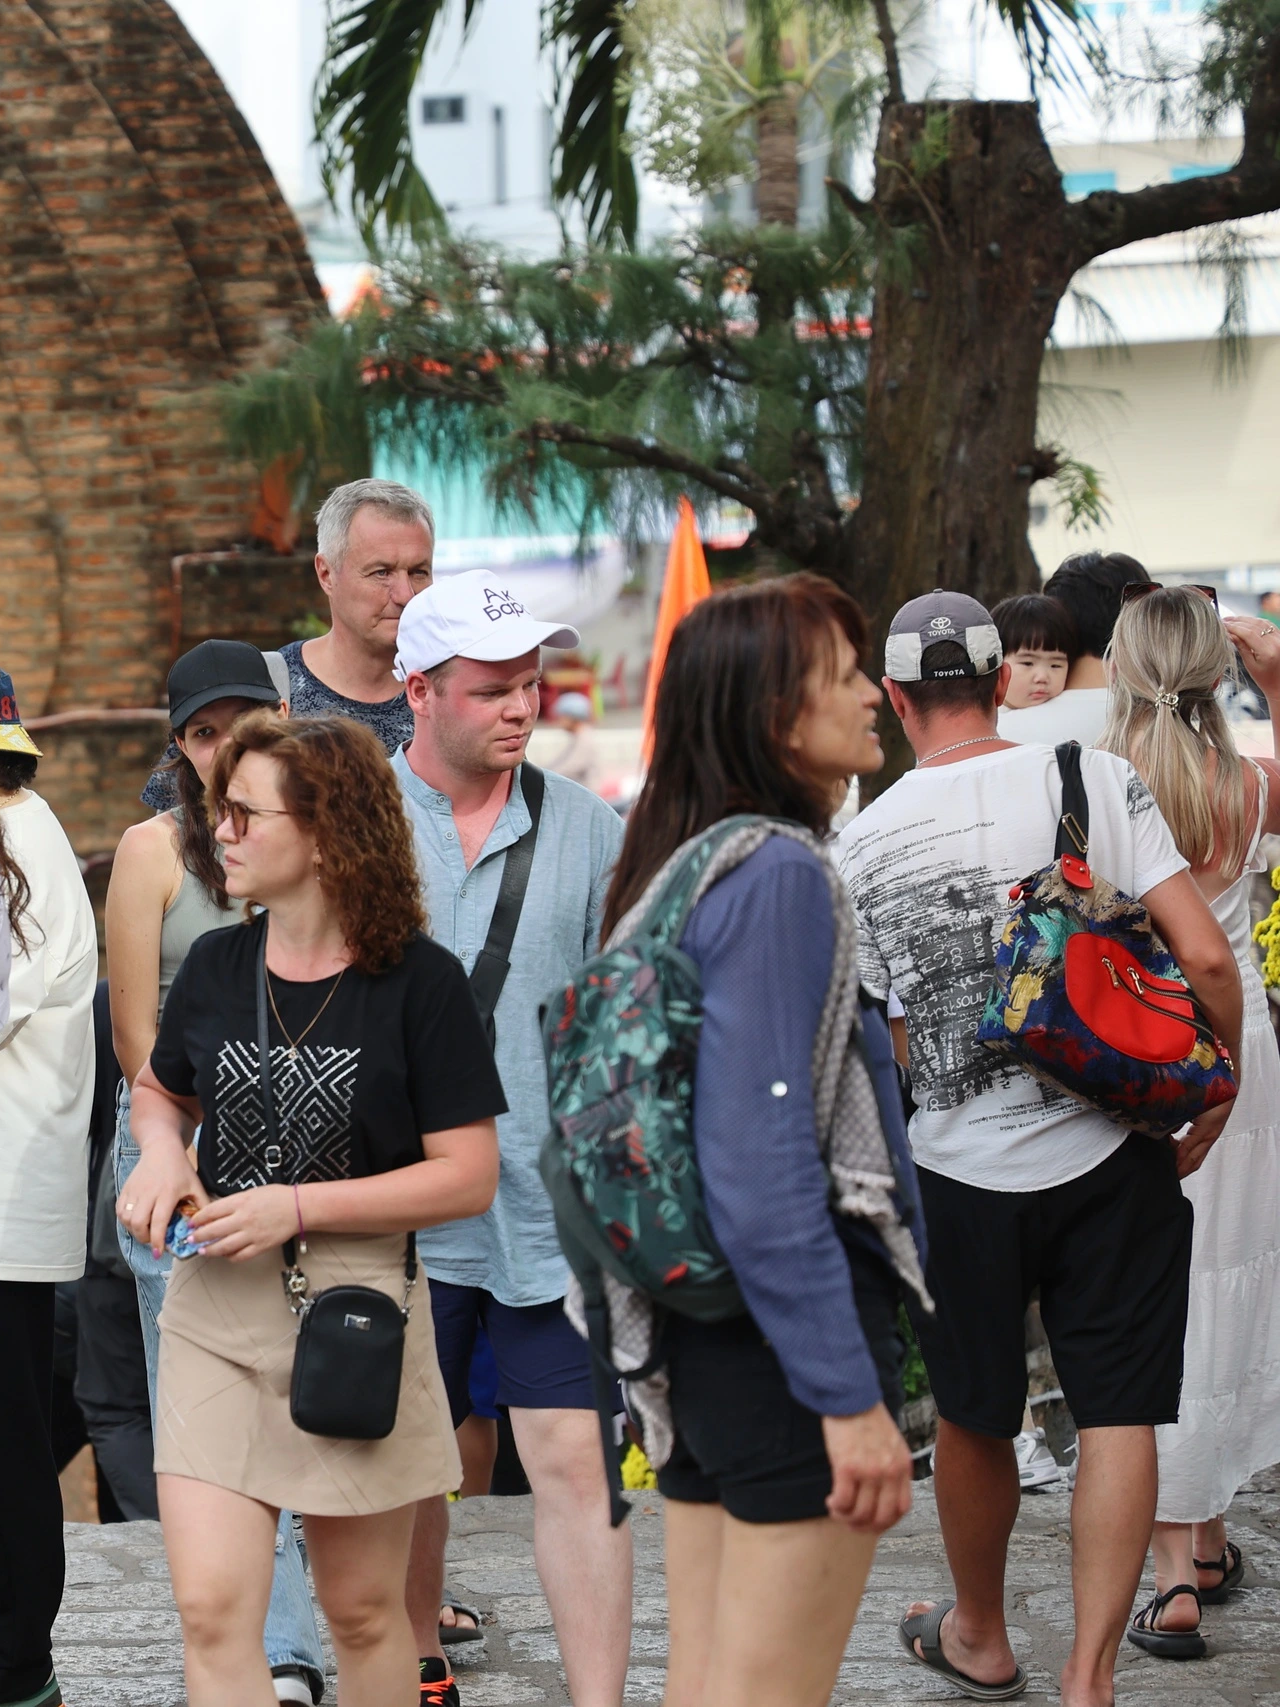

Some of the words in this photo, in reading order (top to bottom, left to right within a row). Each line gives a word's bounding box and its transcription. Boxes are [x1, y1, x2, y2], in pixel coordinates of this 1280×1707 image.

[483, 588, 516, 604] Ак
[483, 602, 531, 622] Бар
[927, 628, 956, 637] TOYOTA
[933, 669, 965, 677] TOYOTA
[956, 991, 986, 1009] SOUL
[918, 1063, 935, 1083] rock
